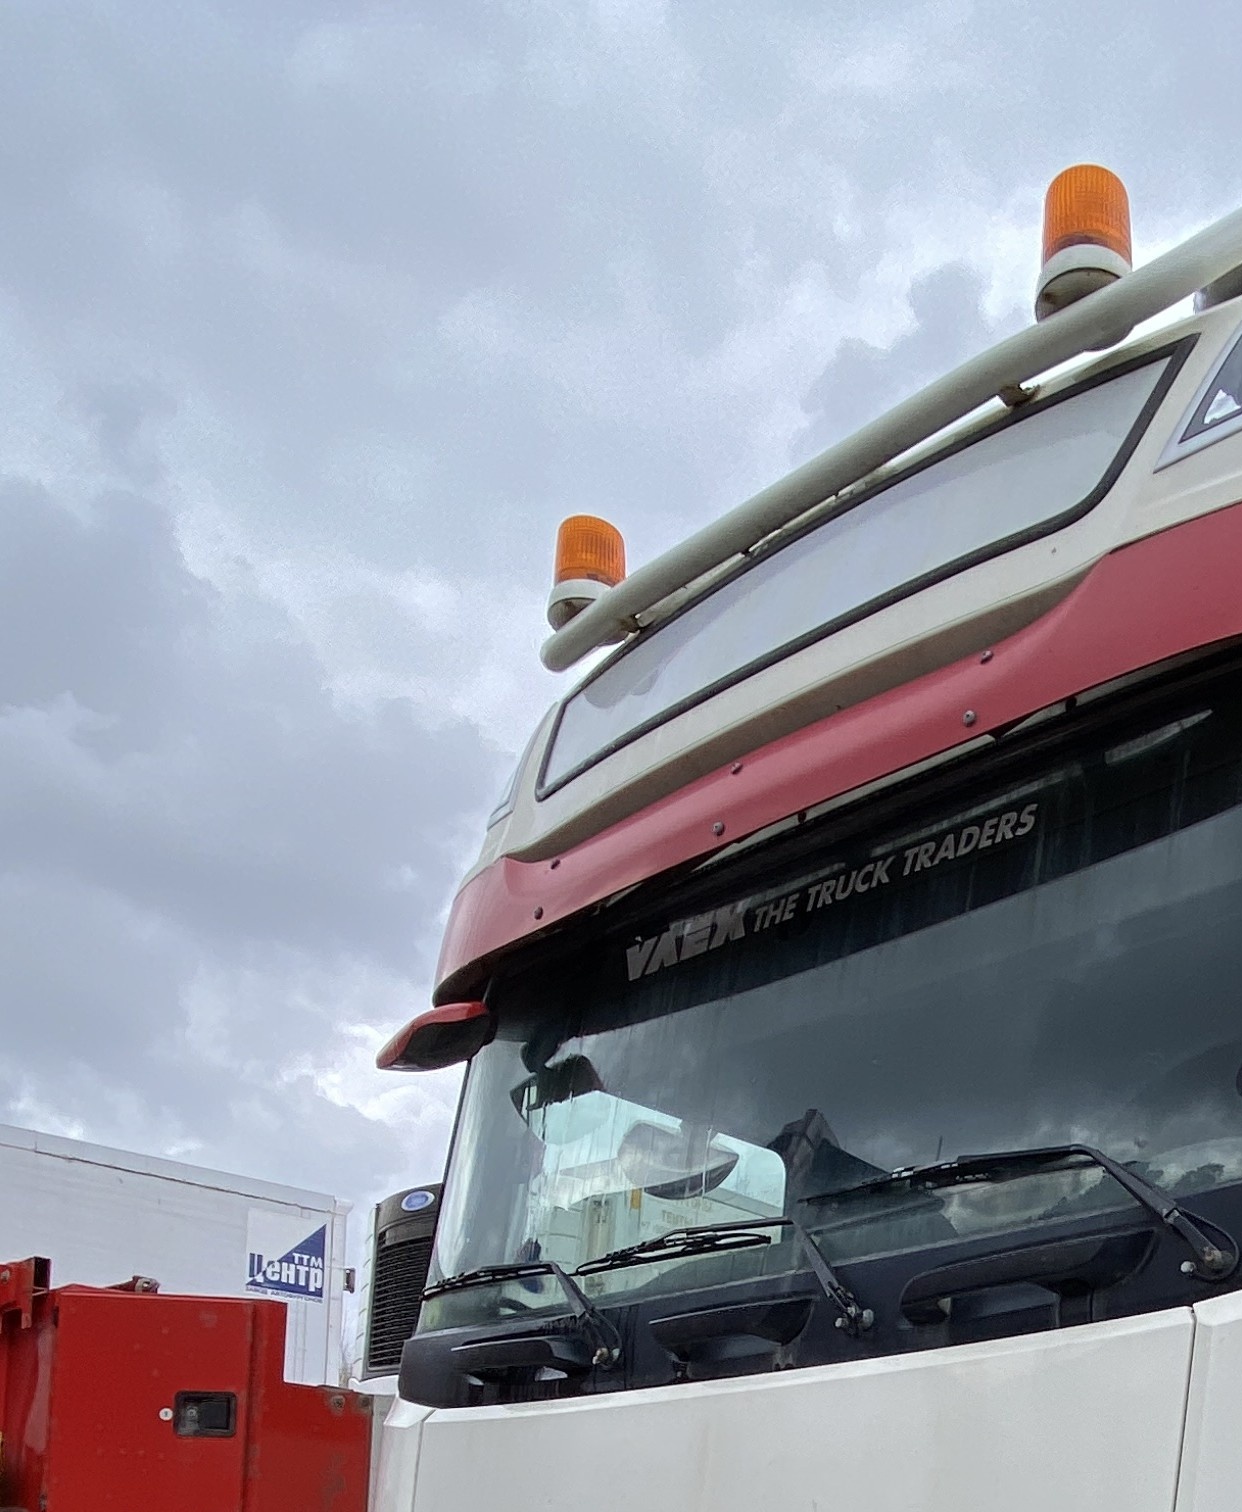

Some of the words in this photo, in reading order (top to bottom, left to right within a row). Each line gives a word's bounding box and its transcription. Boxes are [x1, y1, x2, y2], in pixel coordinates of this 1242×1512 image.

[753, 893, 800, 932] THE
[806, 855, 897, 912] TRUCK
[902, 803, 1039, 876] TRADERS
[249, 1253, 323, 1291] Центр
[292, 1252, 323, 1268] ТТМ
